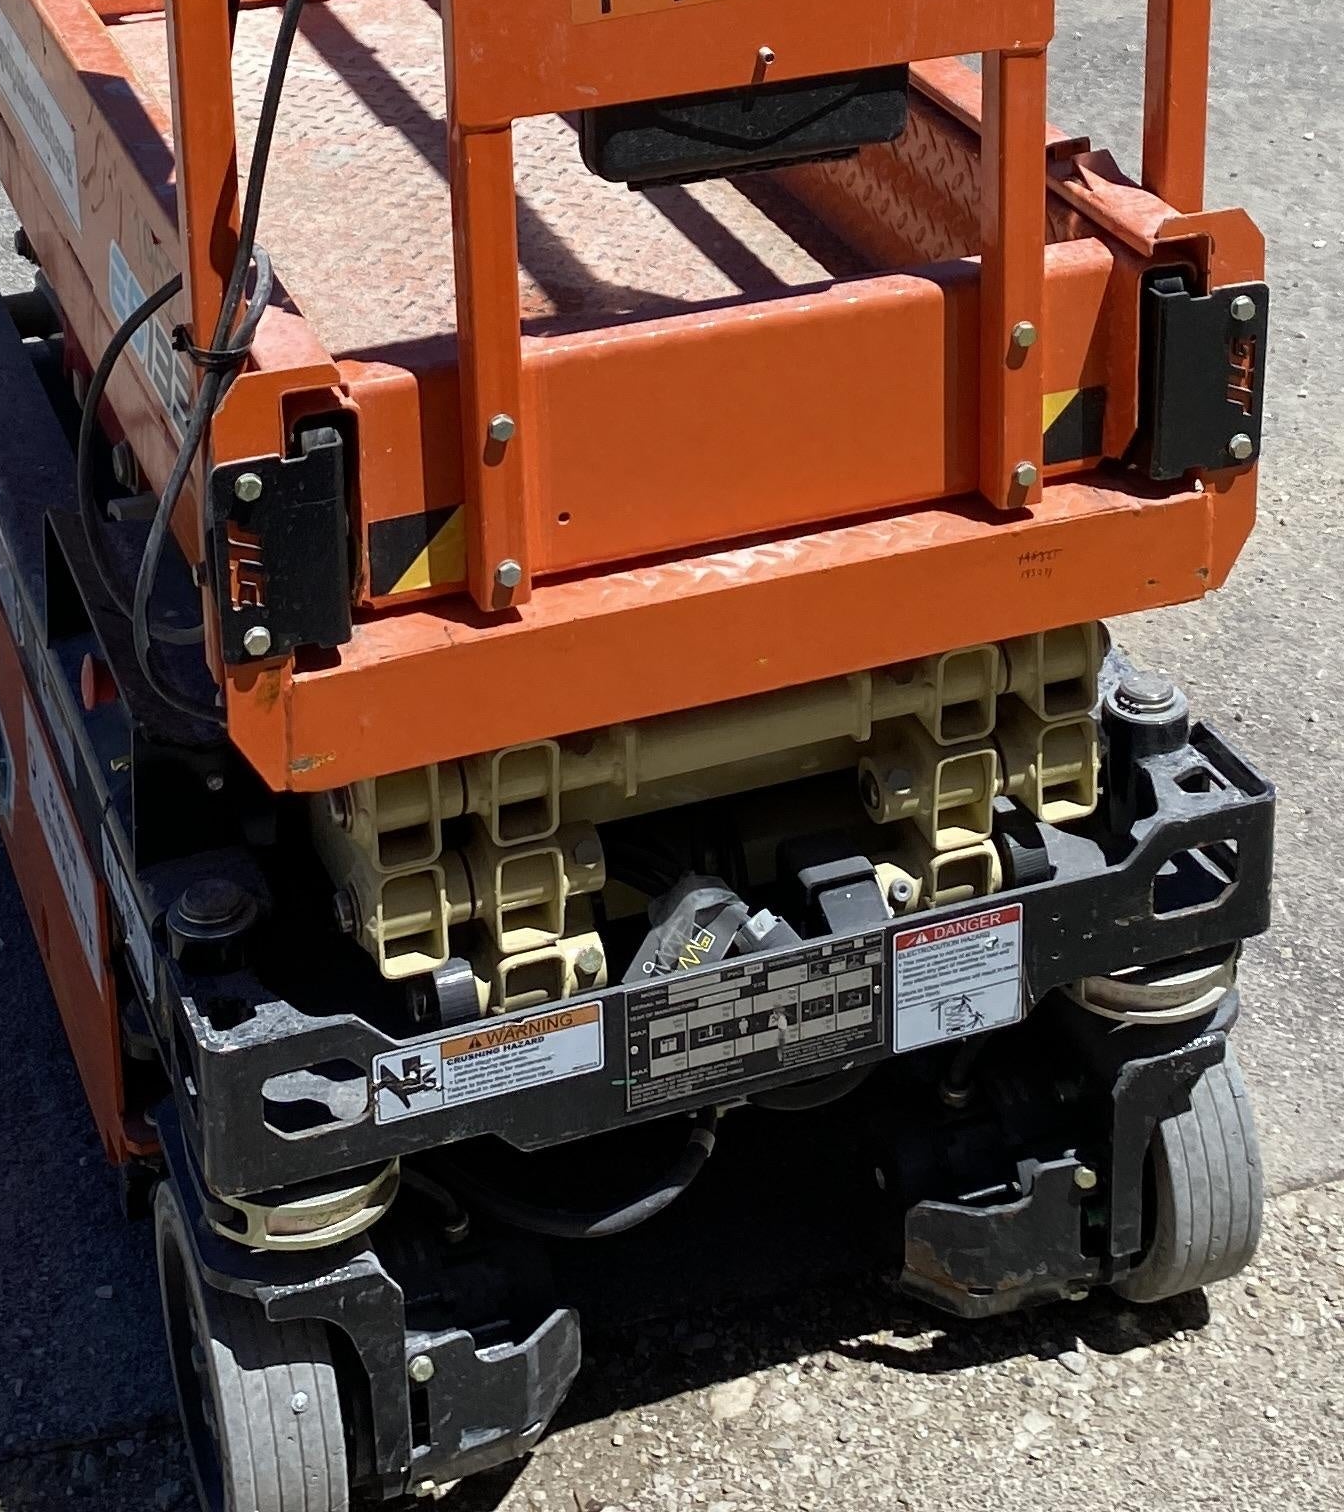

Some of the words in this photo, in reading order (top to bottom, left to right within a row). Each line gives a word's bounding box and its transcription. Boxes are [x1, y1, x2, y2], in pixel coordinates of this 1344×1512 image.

[933, 912, 1002, 940] DANGER
[485, 1013, 573, 1045] WARNING
[446, 1048, 501, 1066] CRUSHING
[502, 1036, 545, 1052] HAZARD
